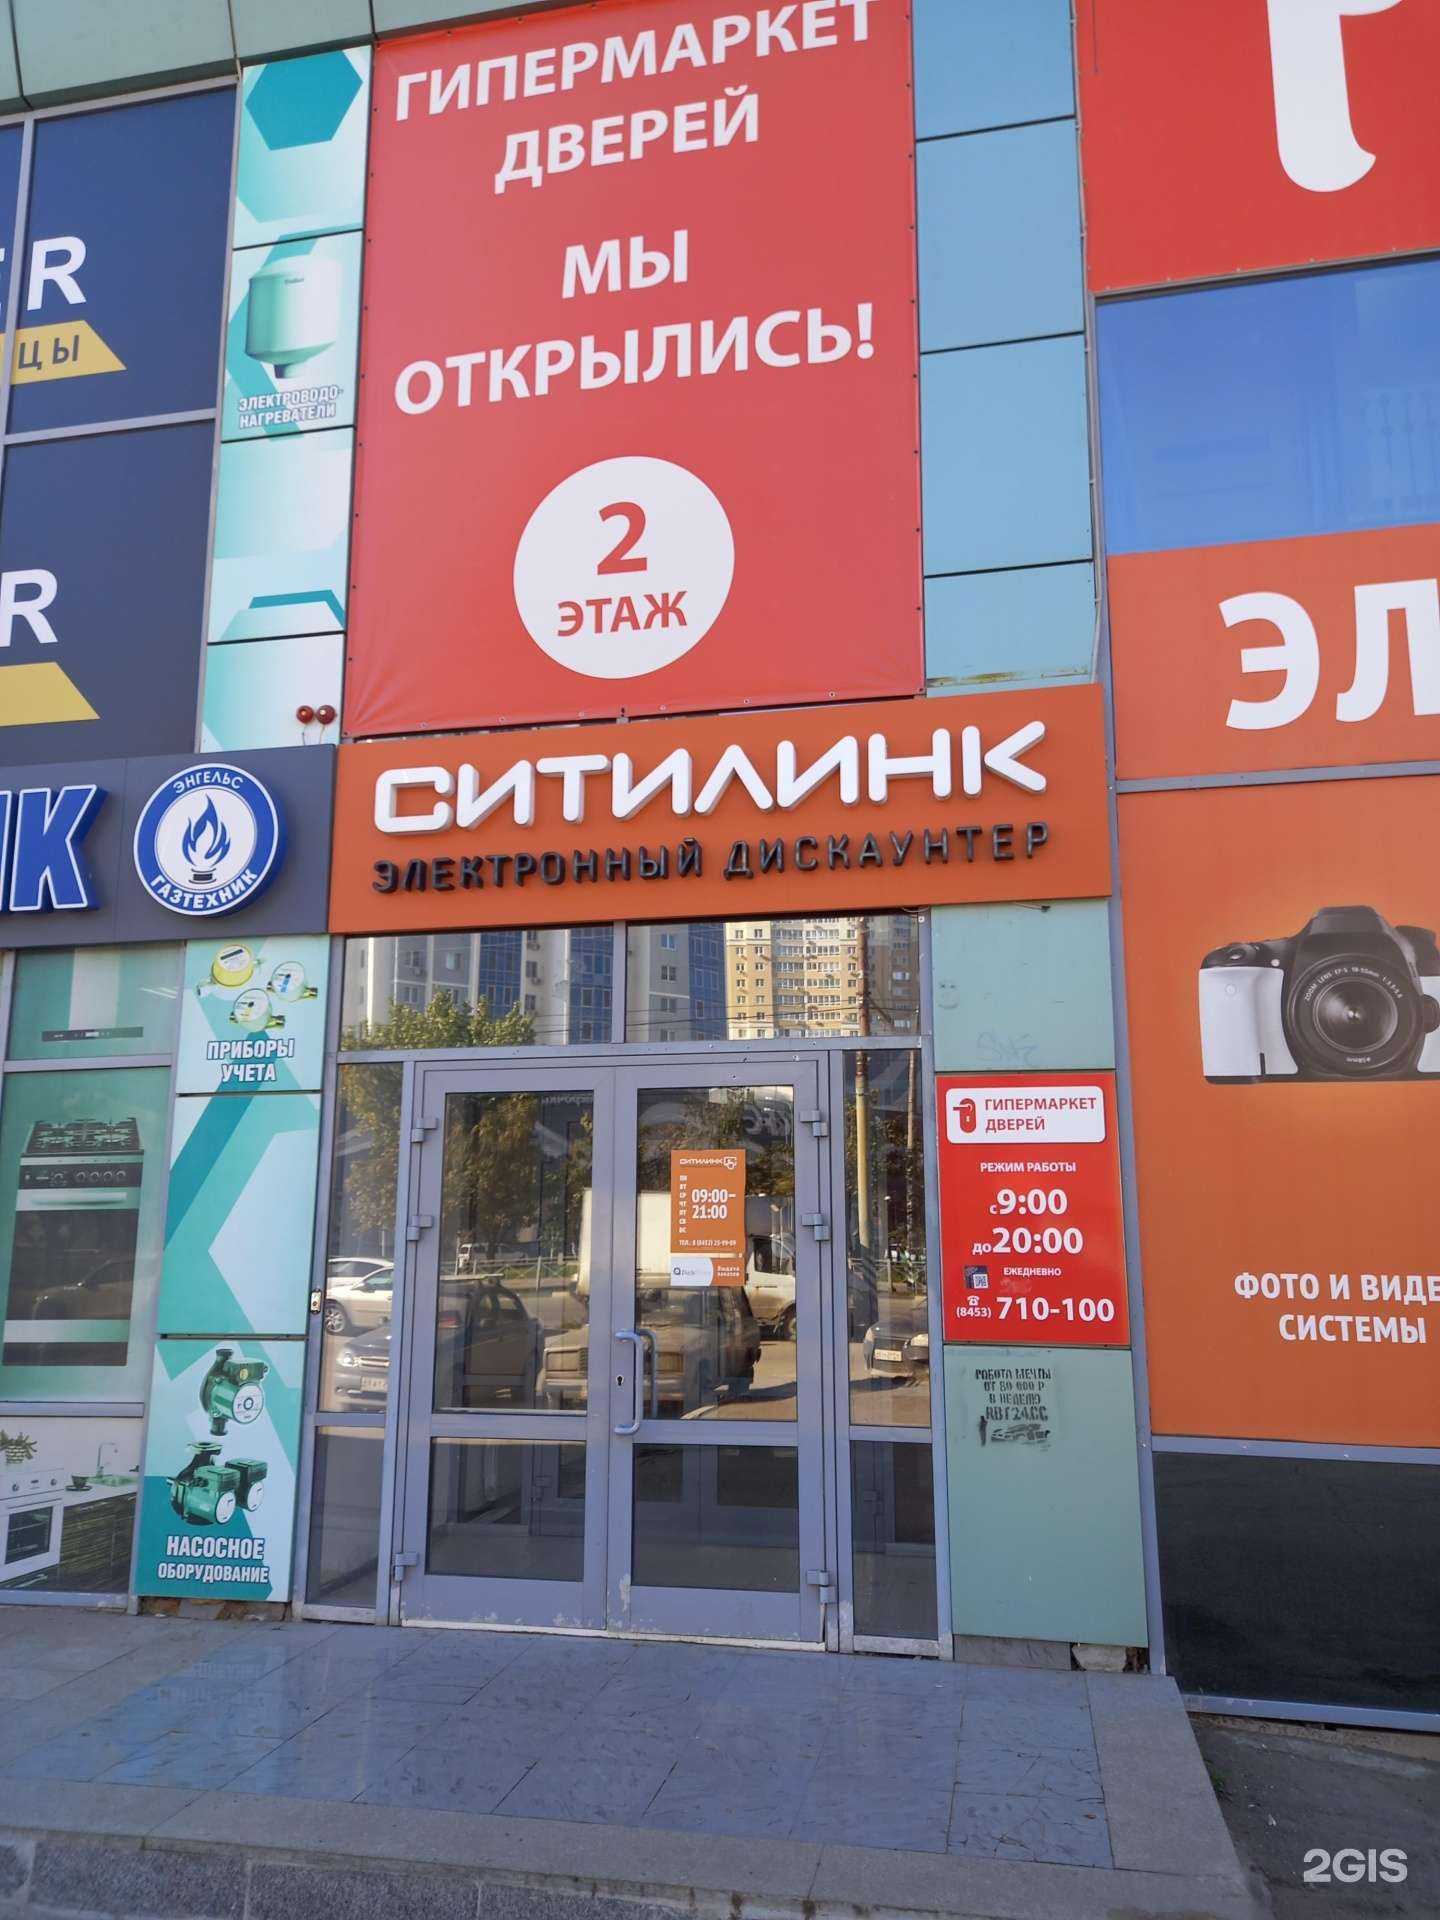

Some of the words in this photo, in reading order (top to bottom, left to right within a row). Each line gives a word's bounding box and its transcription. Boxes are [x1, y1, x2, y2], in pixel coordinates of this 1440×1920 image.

[396, 0, 879, 121] ГИПЕРМАРКЕТ
[494, 85, 759, 194] ДВЕРЕЙ
[562, 230, 688, 299] МЫ
[394, 303, 875, 415] ОТКРЫЛИСЬ!
[240, 403, 337, 429] НАГРЕВАТЕЛИ
[597, 501, 648, 575] 2
[557, 590, 688, 637] ЭТАЖ
[1218, 578, 1440, 730] ЭЛ
[173, 770, 244, 794] ЭНГЕЛЬС
[374, 720, 1047, 834] СИТИЛИНК
[372, 837, 704, 895] ЭЛЕКТРОННЫЙ
[724, 821, 1051, 881] ДИСКАУНТЕР
[150, 870, 258, 909] ГАЗТЕХНИК
[207, 1039, 295, 1060] ПРИБОРЫ
[222, 1063, 277, 1083] УЧЕТА
[985, 1097, 1097, 1112] ГИПЕРМАРКЕТ
[985, 1116, 1046, 1133] ДВЕРЕЙ
[980, 1162, 1025, 1173] РЕЖИМ
[1026, 1162, 1077, 1173] РАБОТЫ
[692, 1205, 728, 1219] 21:00
[1004, 1267, 1062, 1278] ЕЖЕДНЕВНО
[1234, 1272, 1320, 1299] ФОТО
[1329, 1274, 1350, 1300] И
[1360, 1274, 1440, 1306] ВИДЕ
[956, 1306, 992, 1318] (8453)
[996, 1297, 1115, 1322] 710-100
[1279, 1314, 1427, 1344] СИСТЕМЫ
[166, 1535, 265, 1560] НАСОСНОЕ
[157, 1563, 270, 1584] ОБОРУДОВАНИЕ
